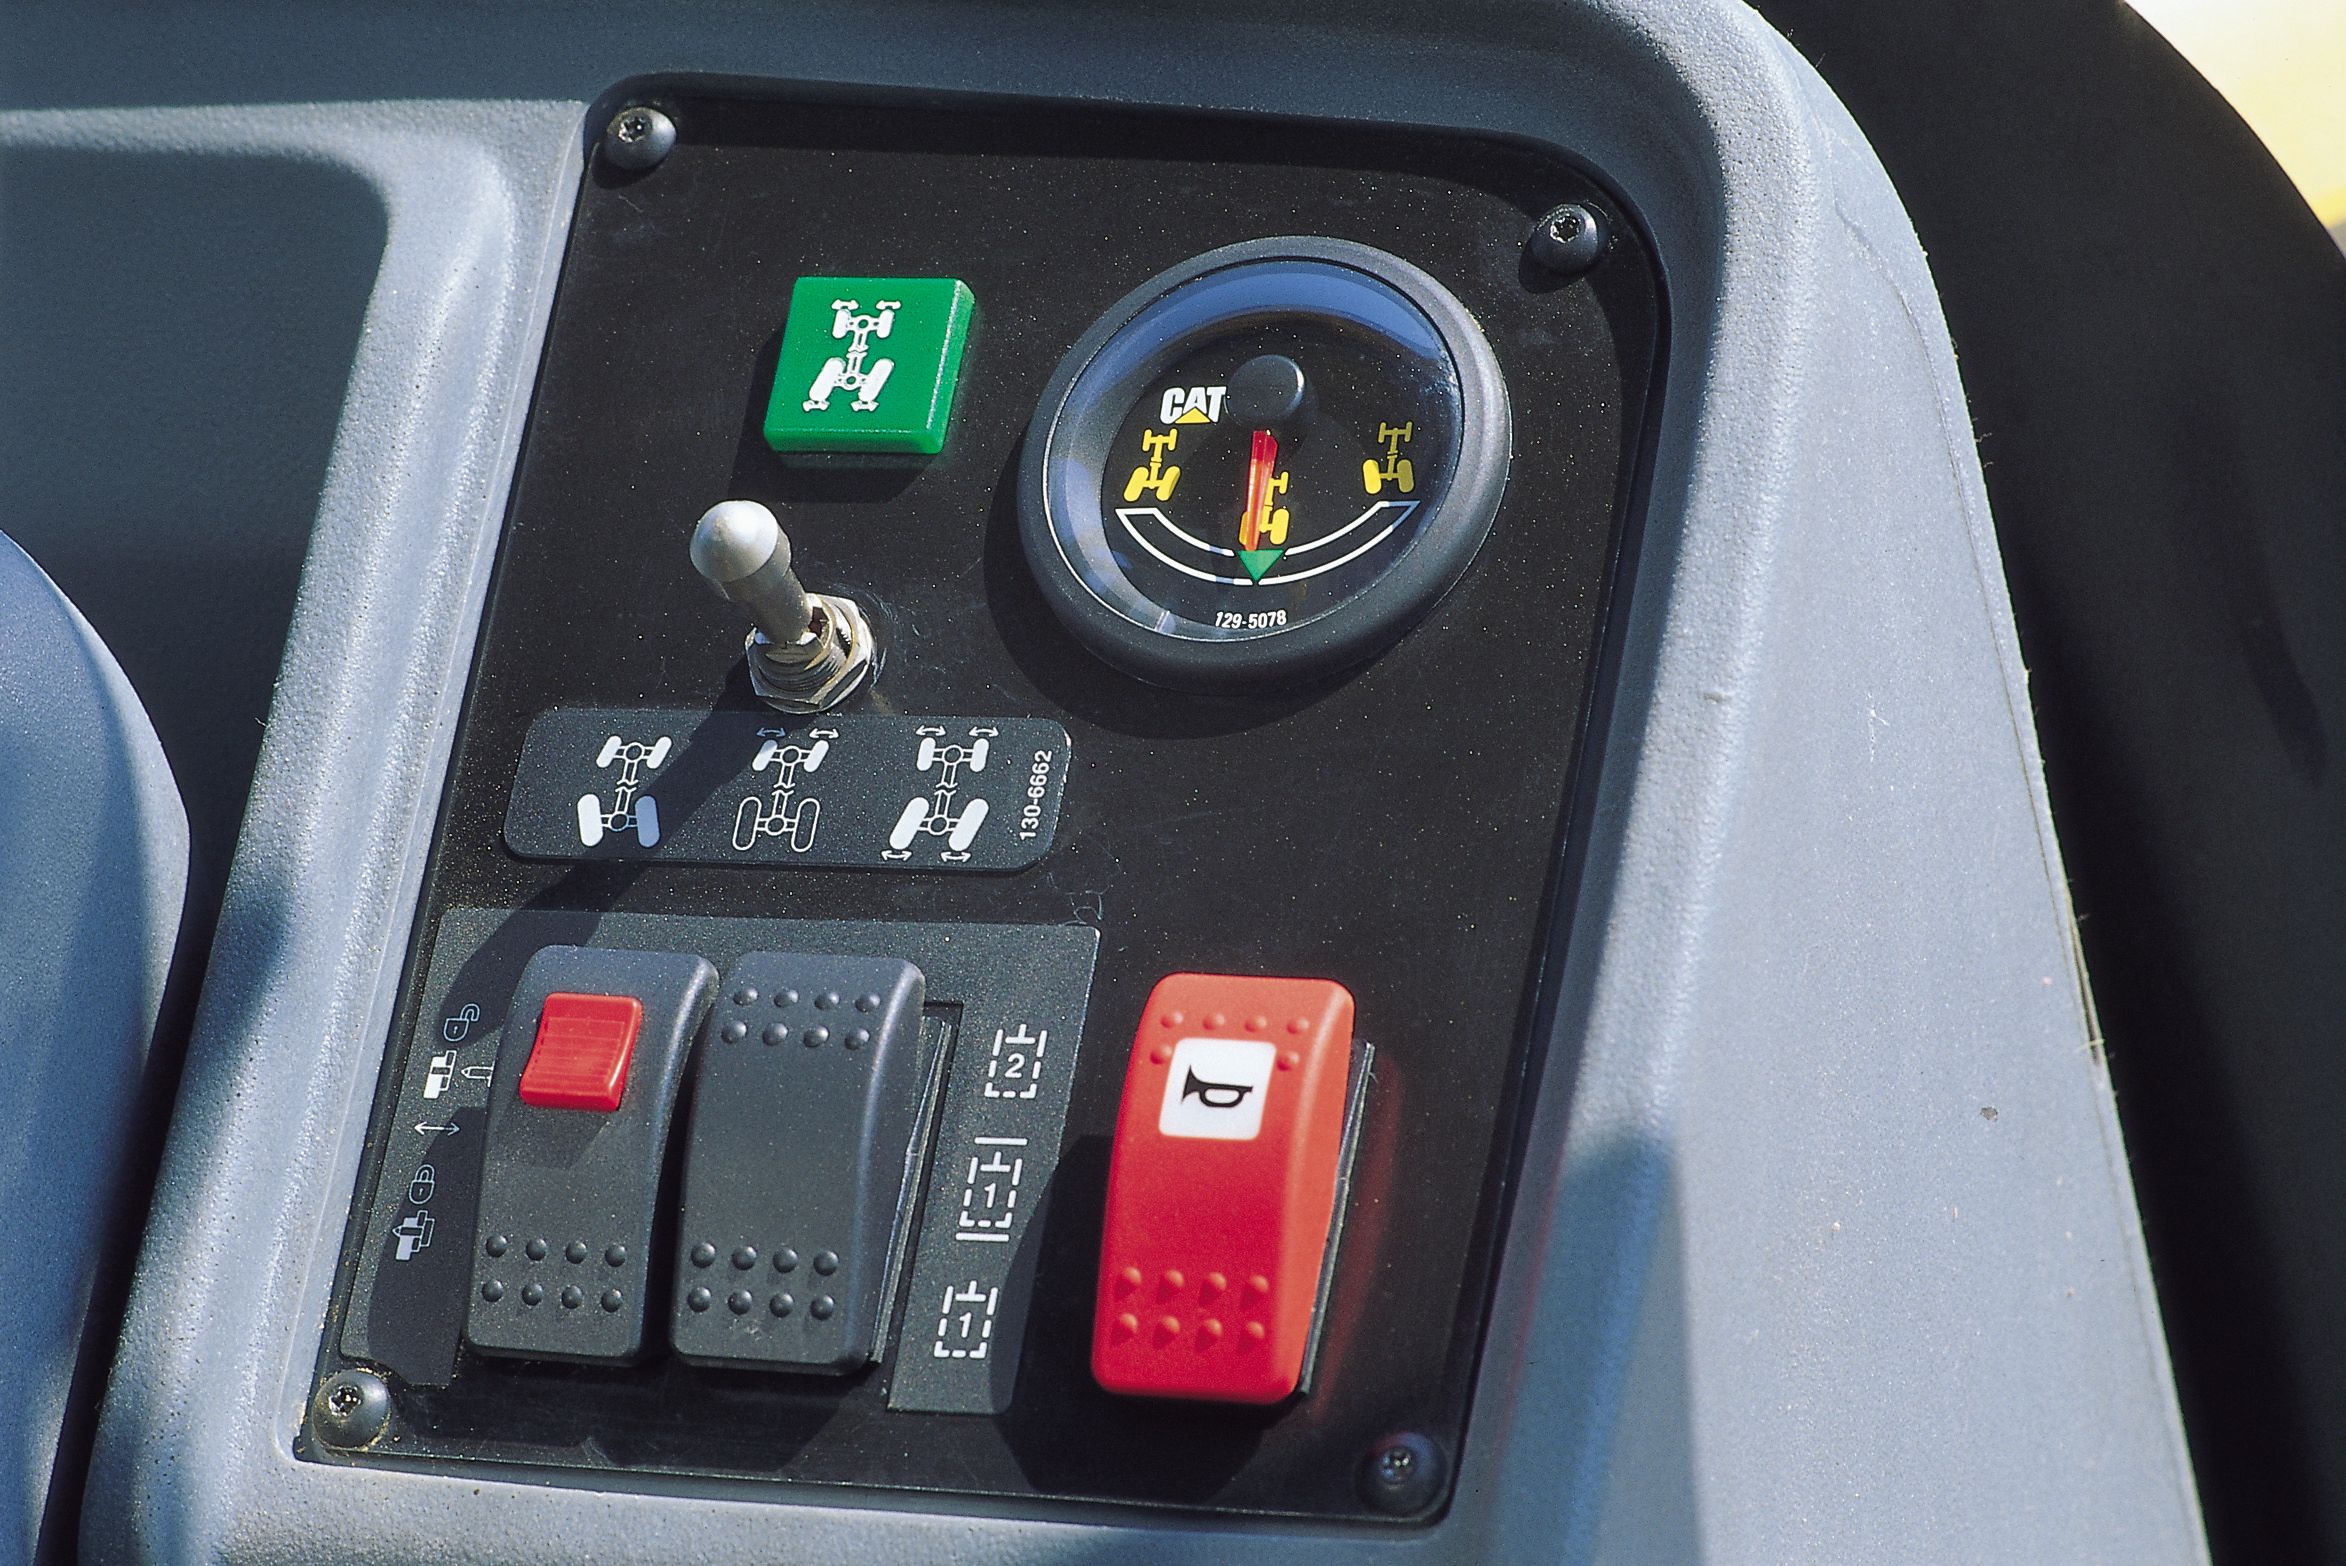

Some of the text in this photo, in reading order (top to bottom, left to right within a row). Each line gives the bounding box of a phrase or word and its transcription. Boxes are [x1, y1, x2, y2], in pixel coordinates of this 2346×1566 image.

[1160, 386, 1227, 424] CAT
[1215, 610, 1287, 629] 129-5078
[1019, 750, 1053, 840] 130-6662
[1005, 1053, 1025, 1079] 2
[984, 1182, 998, 1208] 1
[958, 1312, 973, 1338] 1
